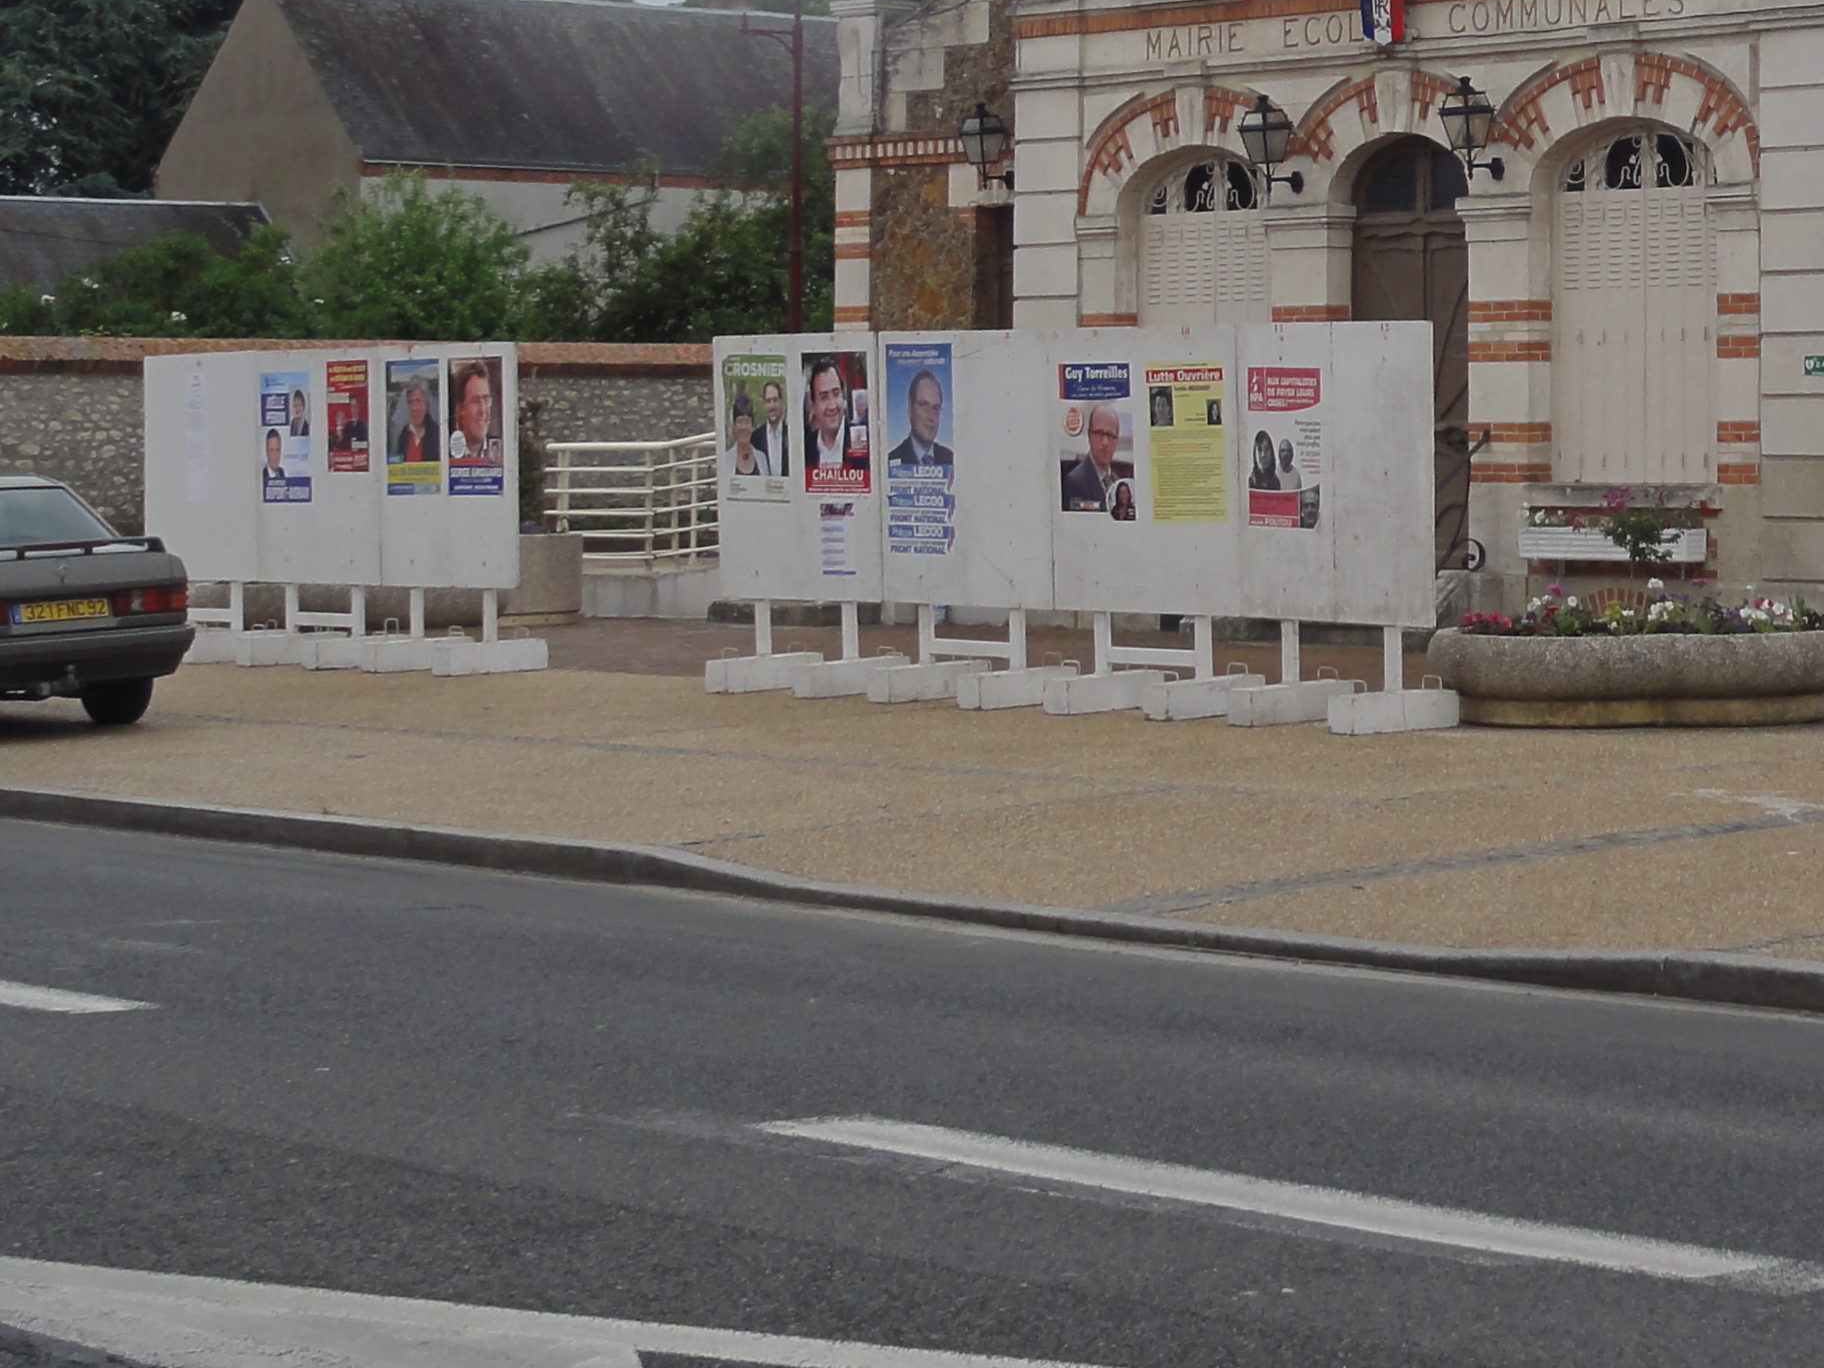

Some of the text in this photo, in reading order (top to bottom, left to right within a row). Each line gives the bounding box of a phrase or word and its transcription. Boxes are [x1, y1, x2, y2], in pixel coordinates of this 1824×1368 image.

[1145, 21, 1244, 60] MAIRIE
[1283, 10, 1408, 49] ECOL
[724, 362, 785, 377] CROSNIER
[1065, 365, 1128, 382] Guy Torreilles
[1149, 369, 1220, 382] Lutte Ouvrière
[812, 469, 864, 480] CHAILLOU
